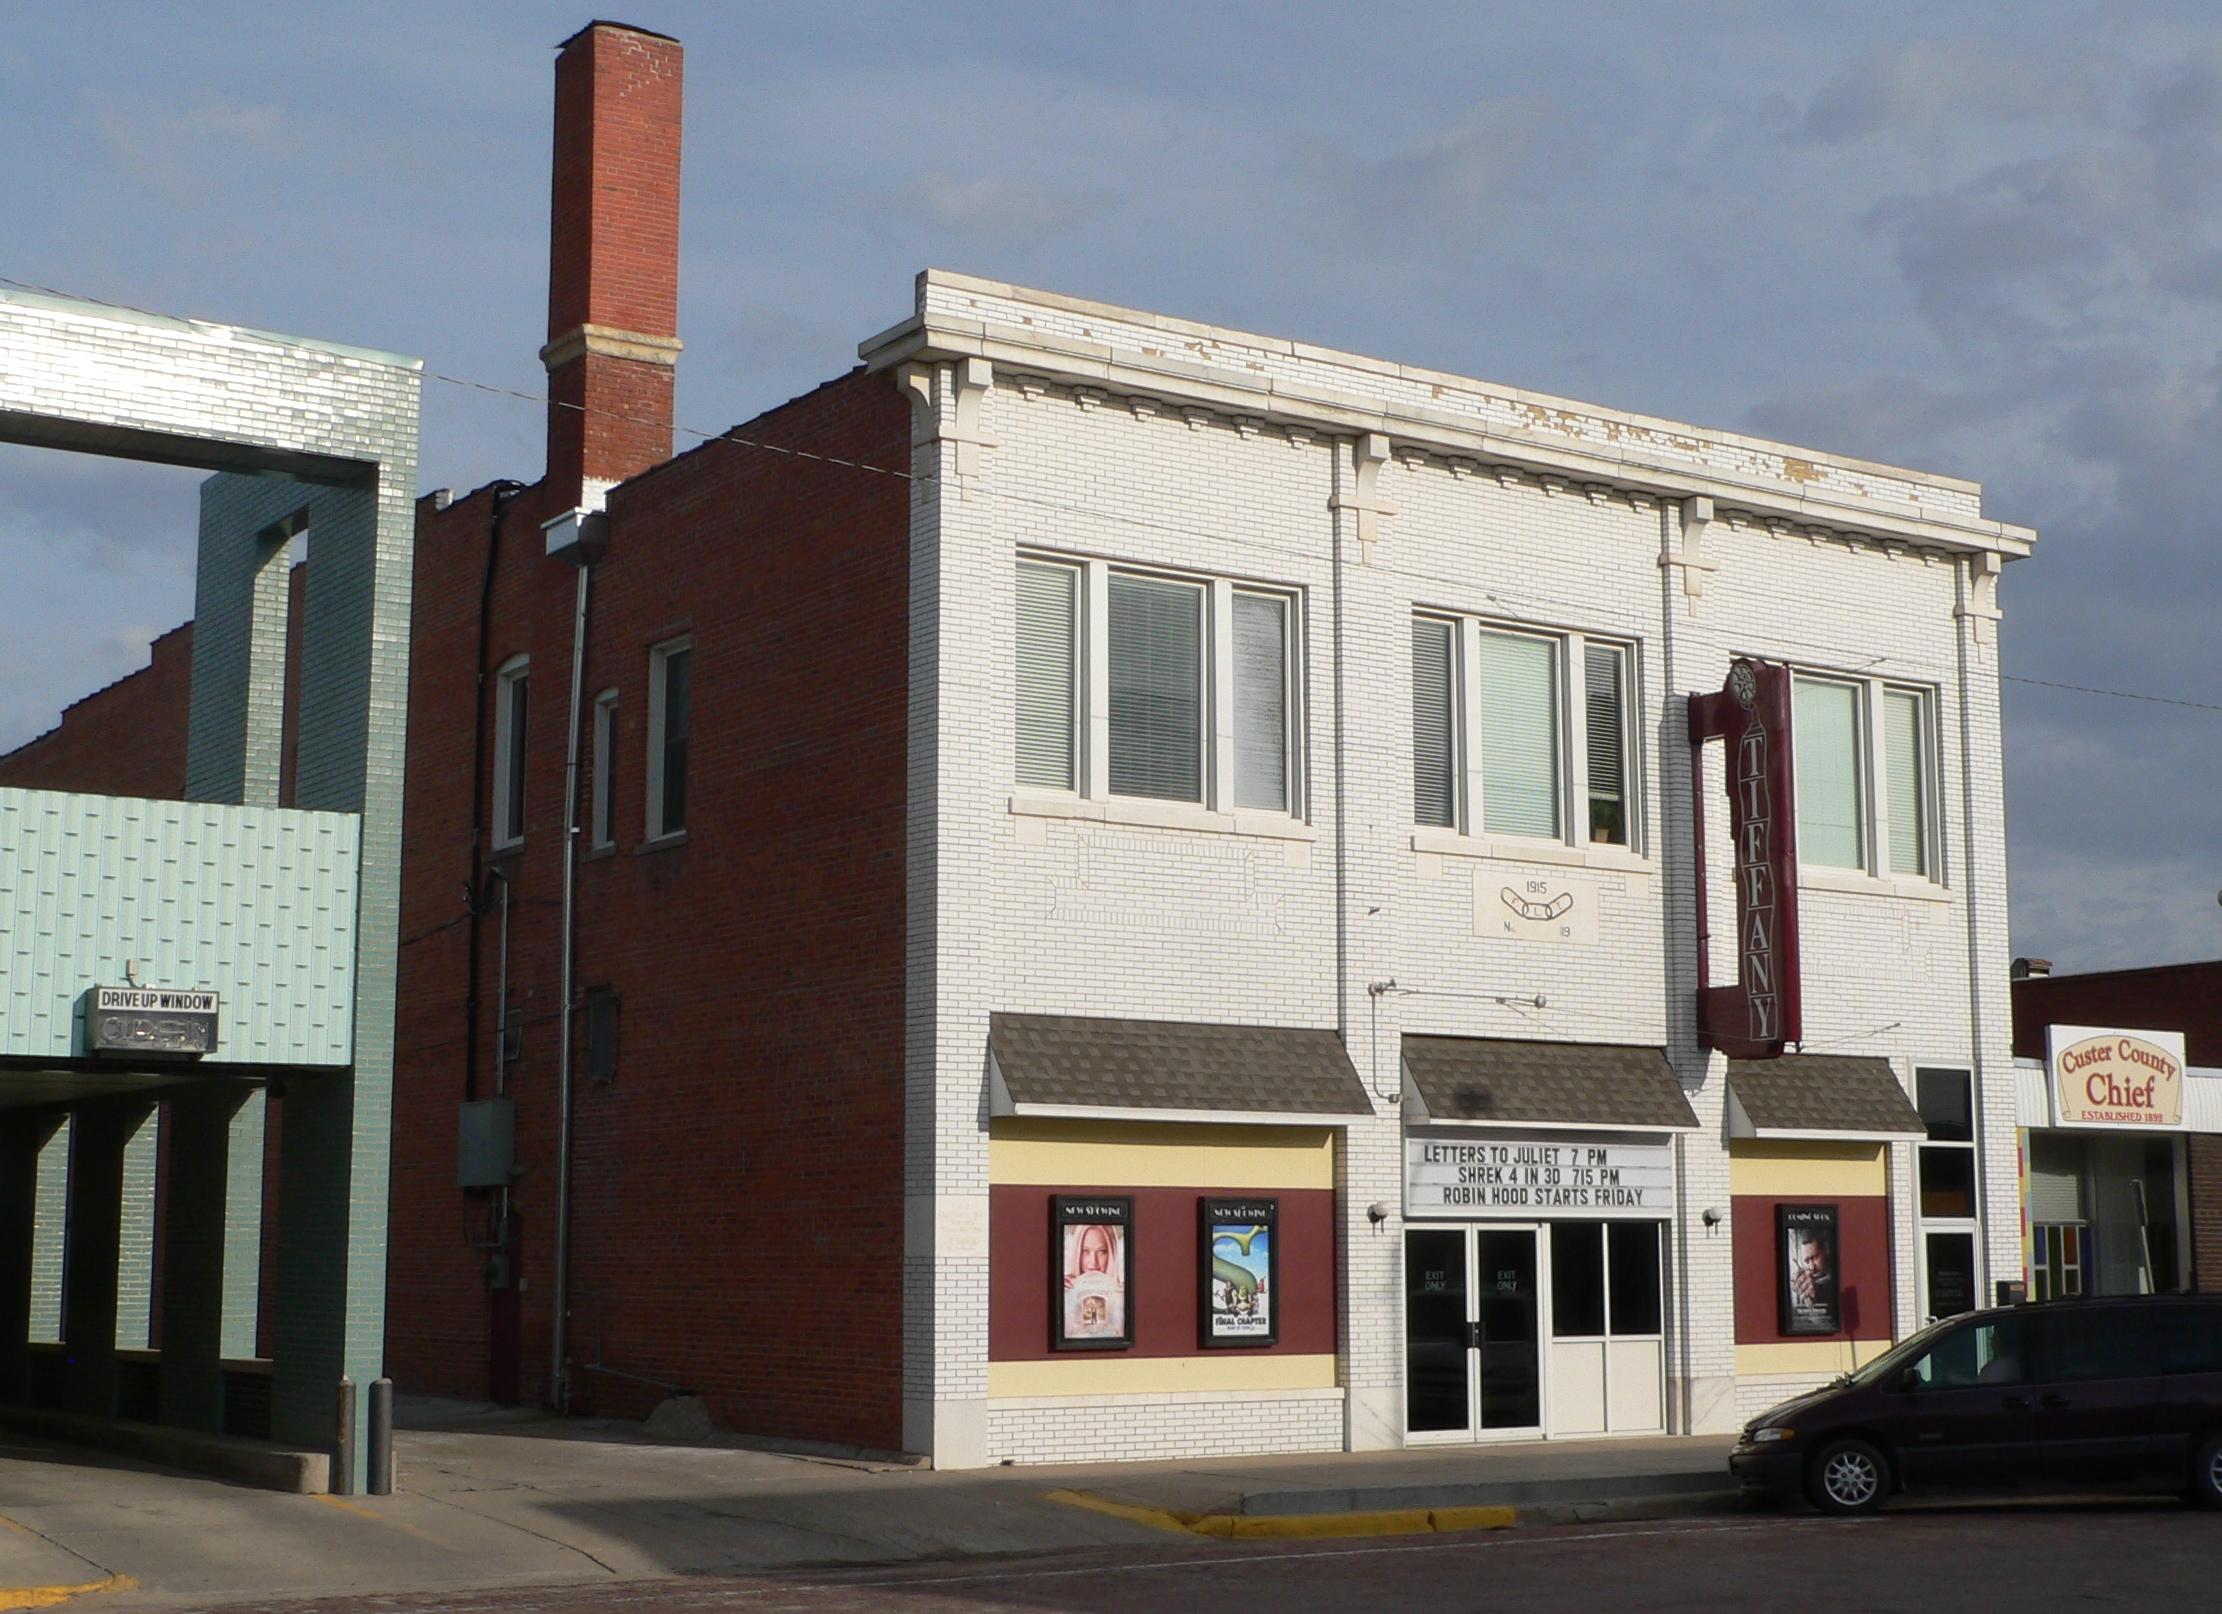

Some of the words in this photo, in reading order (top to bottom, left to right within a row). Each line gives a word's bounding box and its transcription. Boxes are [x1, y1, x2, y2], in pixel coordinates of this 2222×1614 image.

[1526, 880, 1547, 894] 1915
[1743, 737, 1772, 1038] TIFFANY
[102, 991, 140, 1007] DRIVE
[141, 993, 158, 1008] UP
[160, 993, 213, 1010] WINDOW
[2062, 1045, 2113, 1074] Custer
[2118, 1039, 2176, 1081] County
[2086, 1072, 2155, 1108] Chief
[2081, 1110, 2142, 1122] ESTABLISHED
[1424, 1145, 1486, 1164] LETTERS
[1490, 1146, 1509, 1164] TO
[1513, 1147, 1560, 1166] JULIET
[1571, 1149, 1579, 1166] 7
[1587, 1149, 1607, 1166] PM
[1458, 1167, 1504, 1185] SHREK
[1509, 1167, 1518, 1184] 4
[1524, 1168, 1539, 1185] IN
[1544, 1168, 1561, 1185] 3D
[1573, 1168, 1594, 1186] 715
[1600, 1169, 1620, 1186] PM
[1443, 1187, 1486, 1205] ROBIN
[1491, 1188, 1529, 1205] HOOD
[1535, 1188, 1589, 1206] STARTS
[1594, 1188, 1643, 1207] FRIDAY
[1424, 1270, 1445, 1280] EXIT
[1497, 1270, 1516, 1280] EXIT
[1424, 1281, 1447, 1291] ONLY
[1496, 1280, 1518, 1291] ONLY
